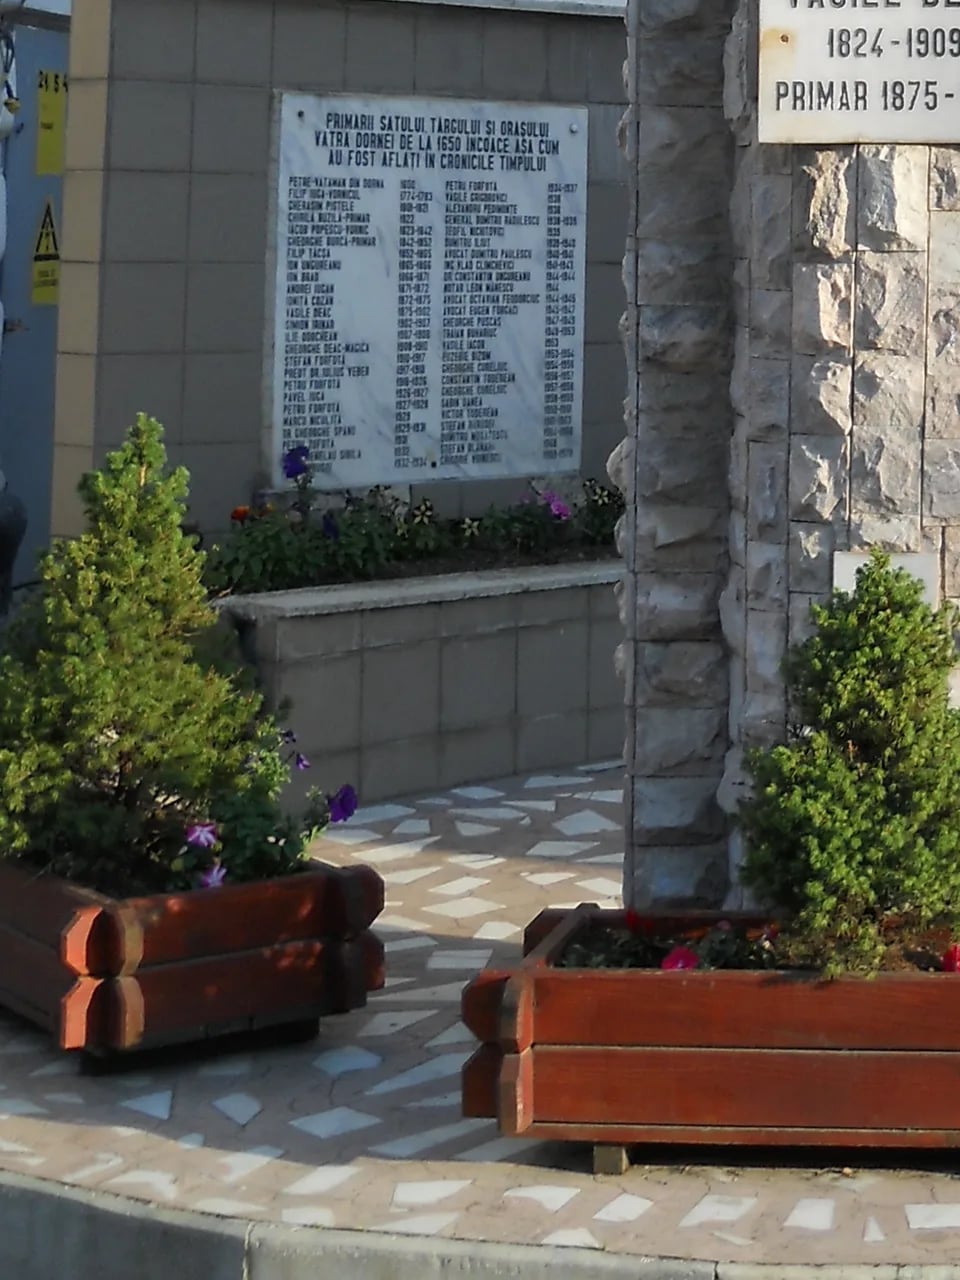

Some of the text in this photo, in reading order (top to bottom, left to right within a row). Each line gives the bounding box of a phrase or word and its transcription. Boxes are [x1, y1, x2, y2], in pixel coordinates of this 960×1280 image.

[775, 81, 868, 111] PRIMAR
[326, 113, 374, 131] PRIMARII
[315, 131, 350, 148] VATRA
[356, 133, 394, 150] DORNEI
[400, 134, 413, 150] DE
[419, 135, 432, 151] LA
[437, 136, 461, 152] 1650
[539, 139, 560, 155] CUM
[328, 150, 343, 166] AU
[348, 150, 375, 167] FOST
[440, 153, 494, 170] CRONICILE
[500, 155, 547, 172] TIMPULUI
